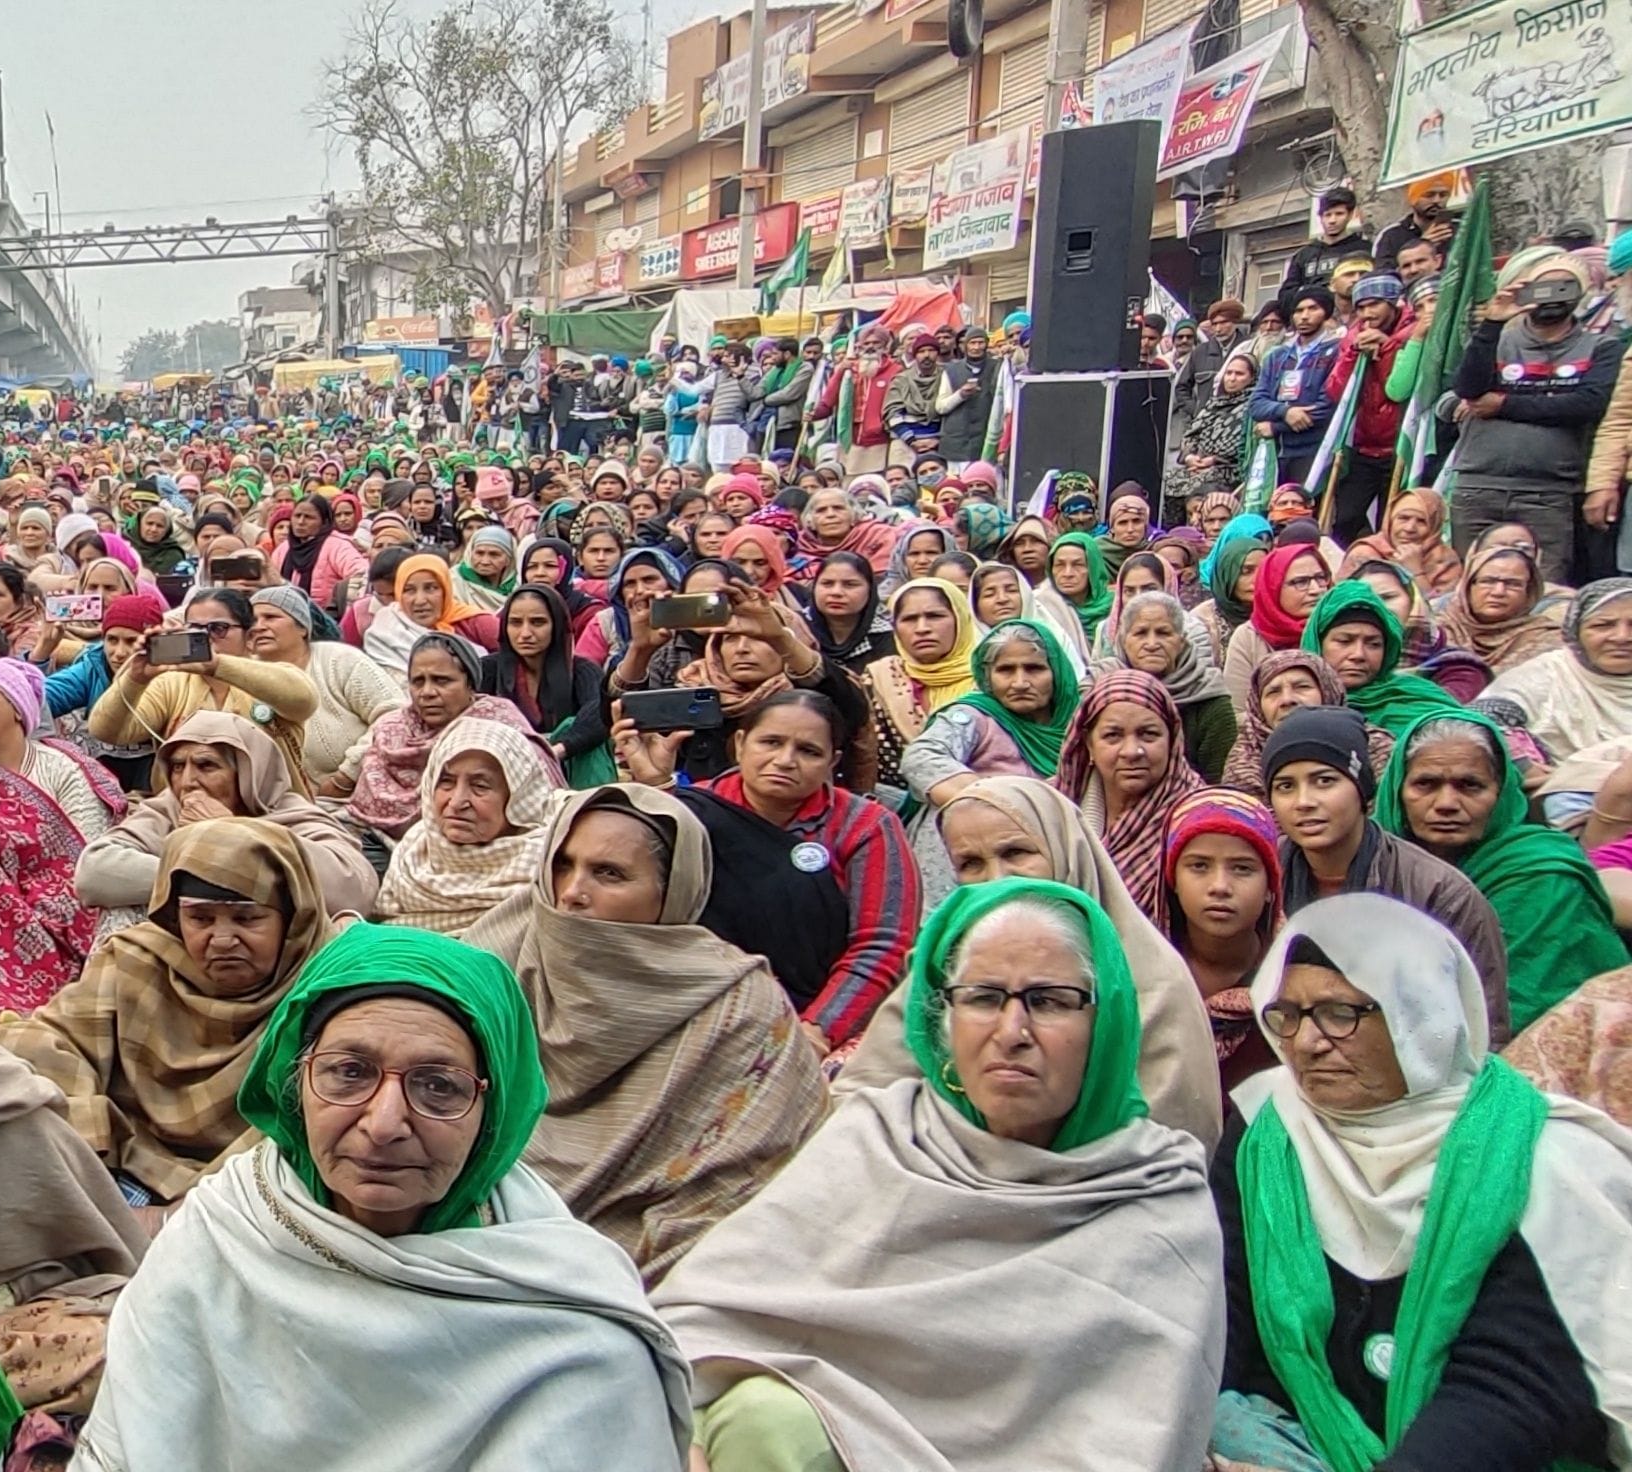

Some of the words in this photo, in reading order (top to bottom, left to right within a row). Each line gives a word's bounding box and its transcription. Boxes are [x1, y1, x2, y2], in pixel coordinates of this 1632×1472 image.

[1407, 30, 1502, 97] भारतीय
[1514, 0, 1607, 49] किसान
[1470, 98, 1601, 150] हरियाणा
